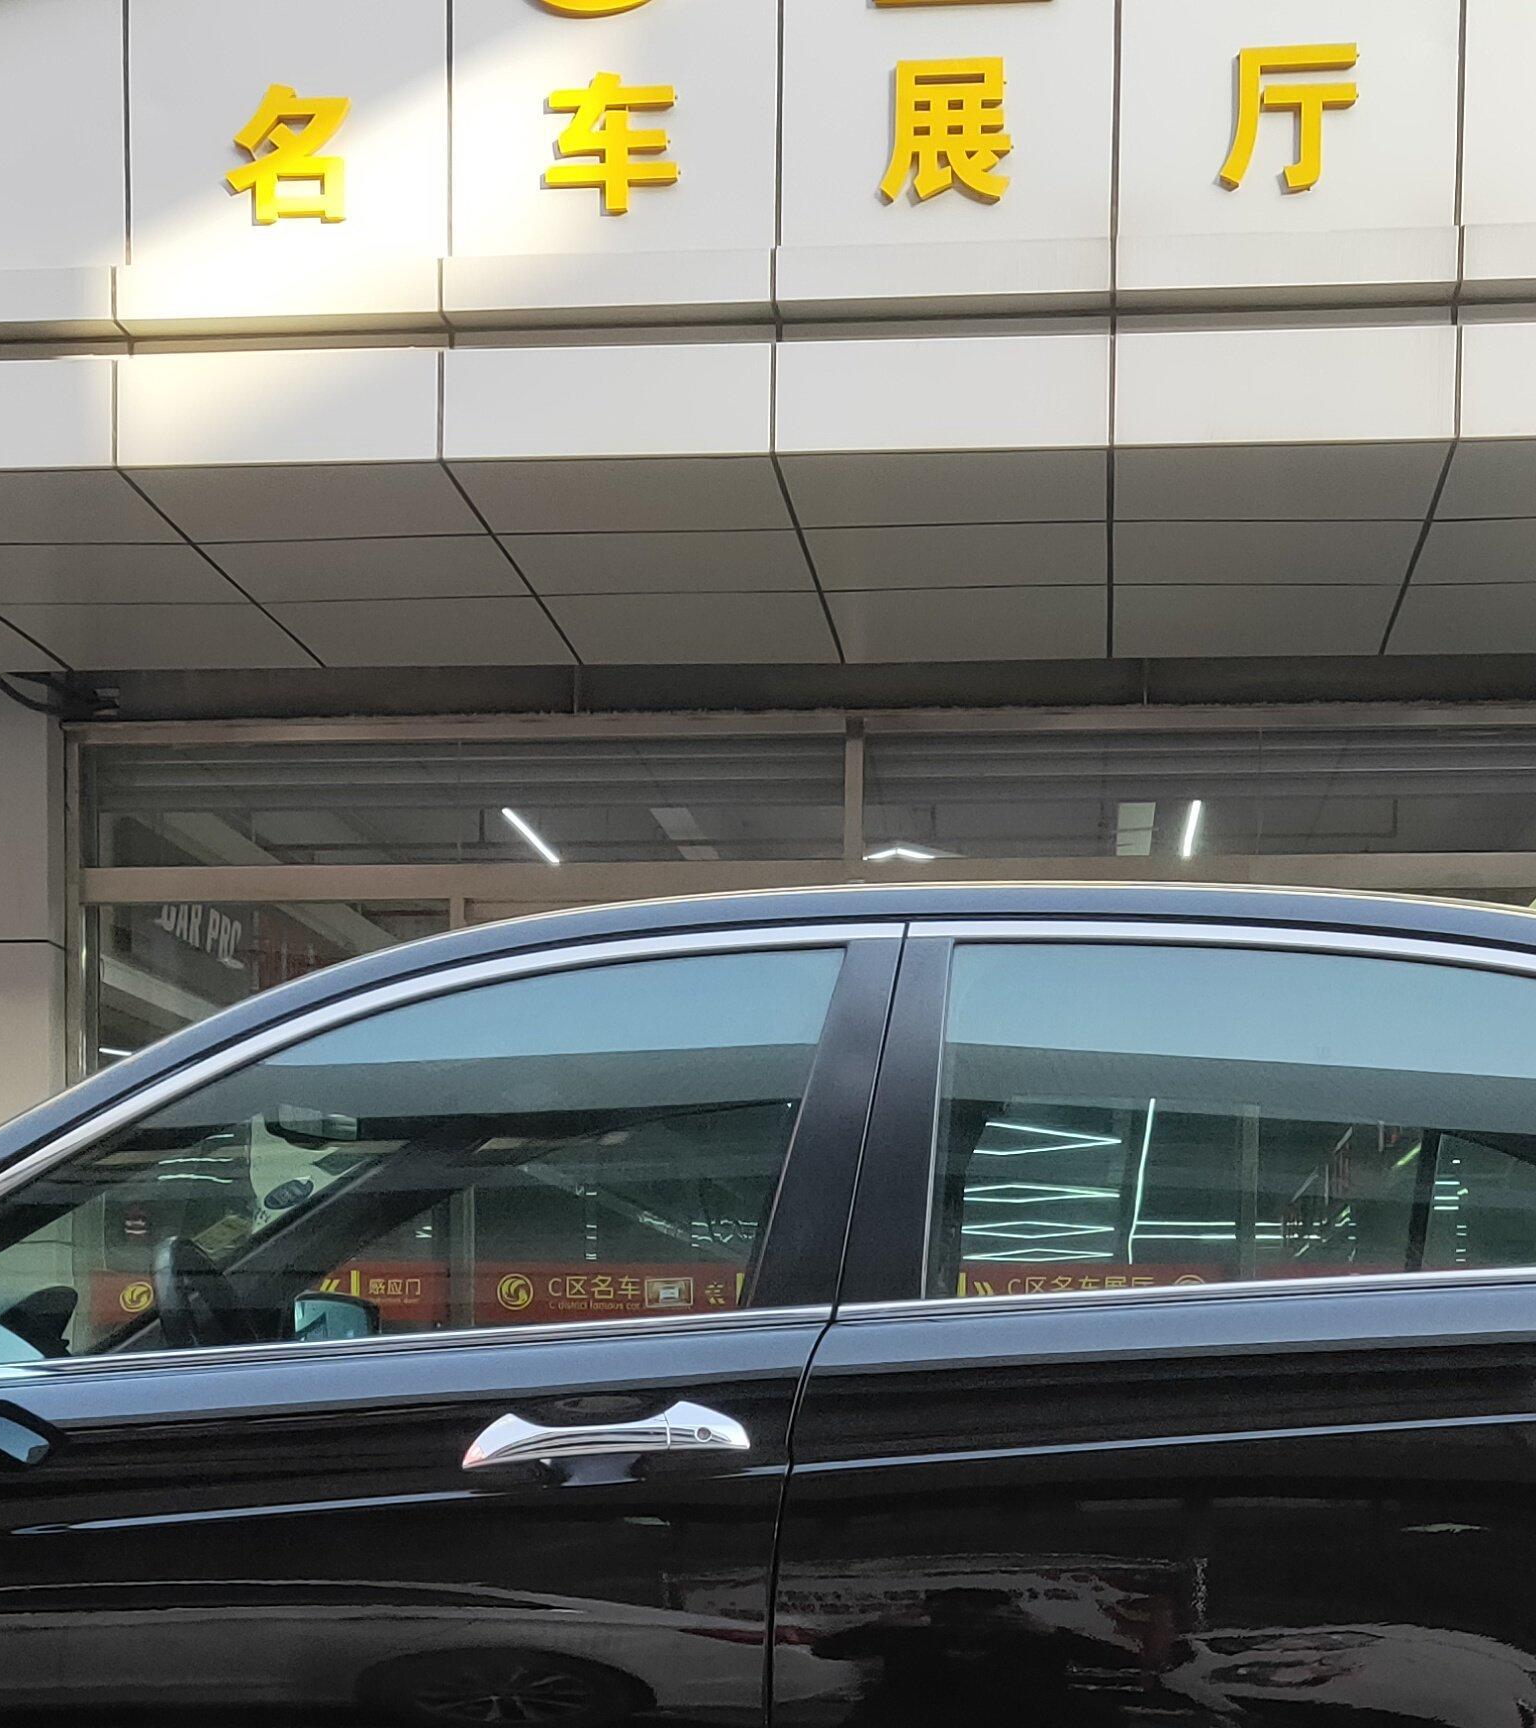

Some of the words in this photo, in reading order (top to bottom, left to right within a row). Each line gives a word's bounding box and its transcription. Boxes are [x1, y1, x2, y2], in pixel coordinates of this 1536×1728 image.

[225, 42, 1359, 225] 名车展厅
[548, 1275, 643, 1299] C区名车
